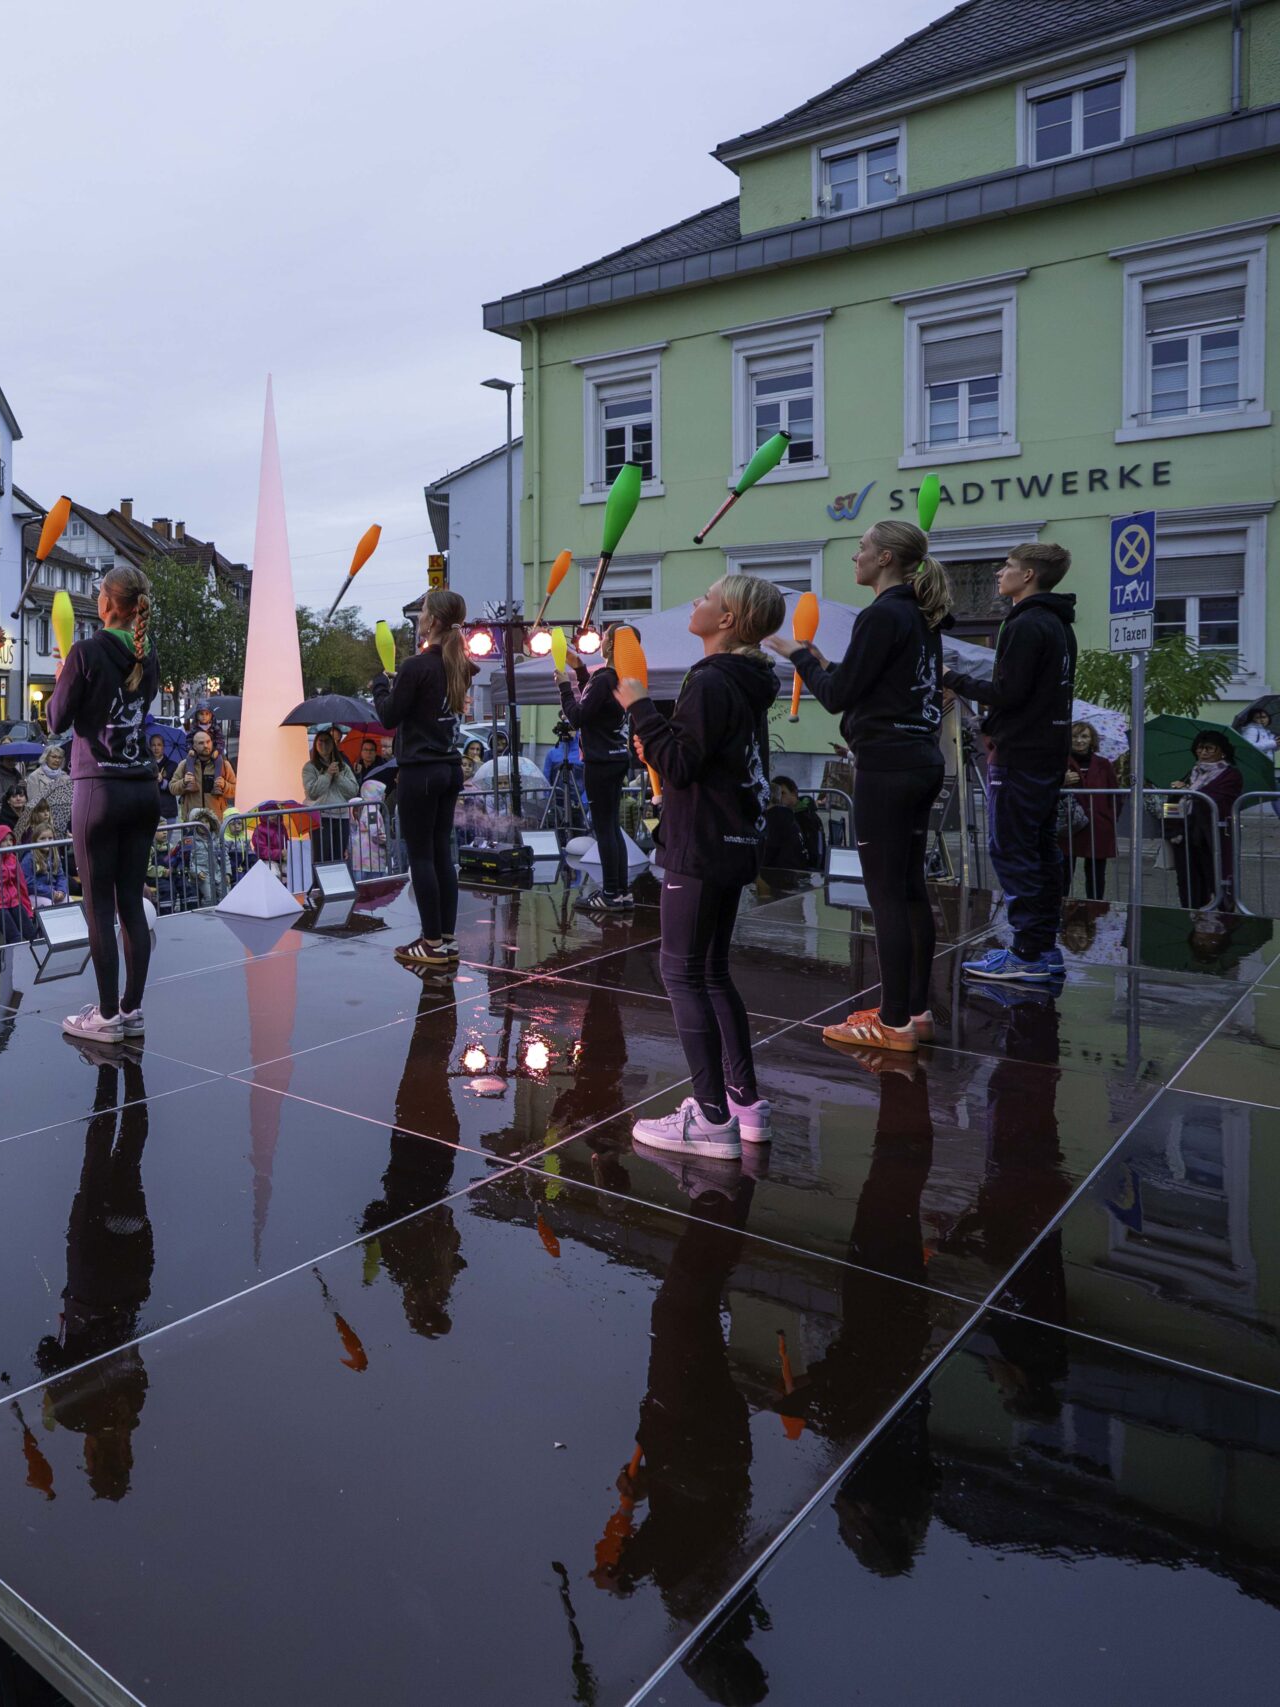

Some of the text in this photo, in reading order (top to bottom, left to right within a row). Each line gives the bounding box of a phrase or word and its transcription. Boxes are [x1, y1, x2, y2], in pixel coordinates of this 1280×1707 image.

[1113, 580, 1150, 606] TAXI
[1114, 627, 1147, 643] 2 Taxen
